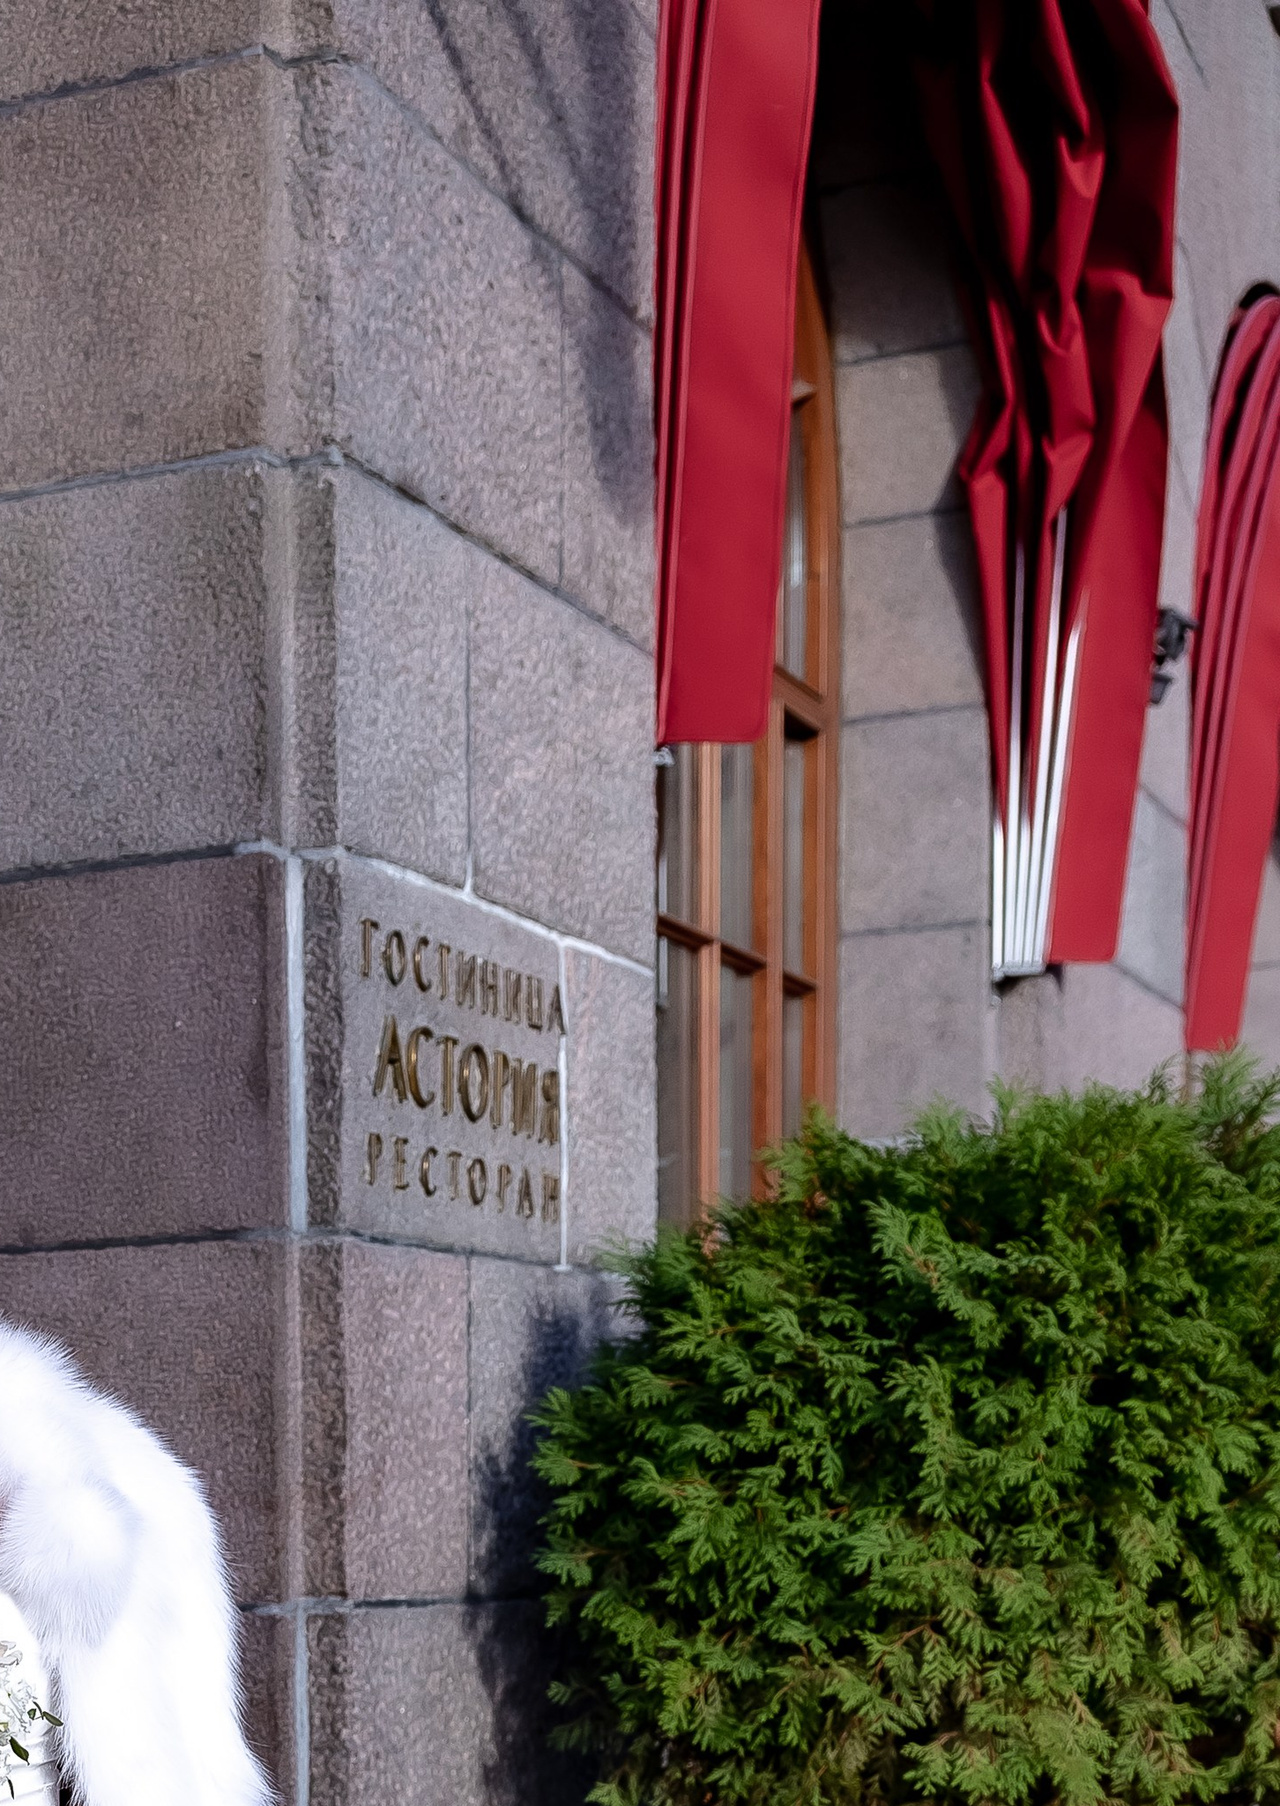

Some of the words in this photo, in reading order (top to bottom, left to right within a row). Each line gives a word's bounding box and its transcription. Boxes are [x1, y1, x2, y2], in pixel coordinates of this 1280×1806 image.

[360, 918, 567, 1036] ГОСТИНИЦА
[372, 1014, 560, 1146] АСТОРИЯ
[367, 1132, 560, 1223] РЕСТОРАН
